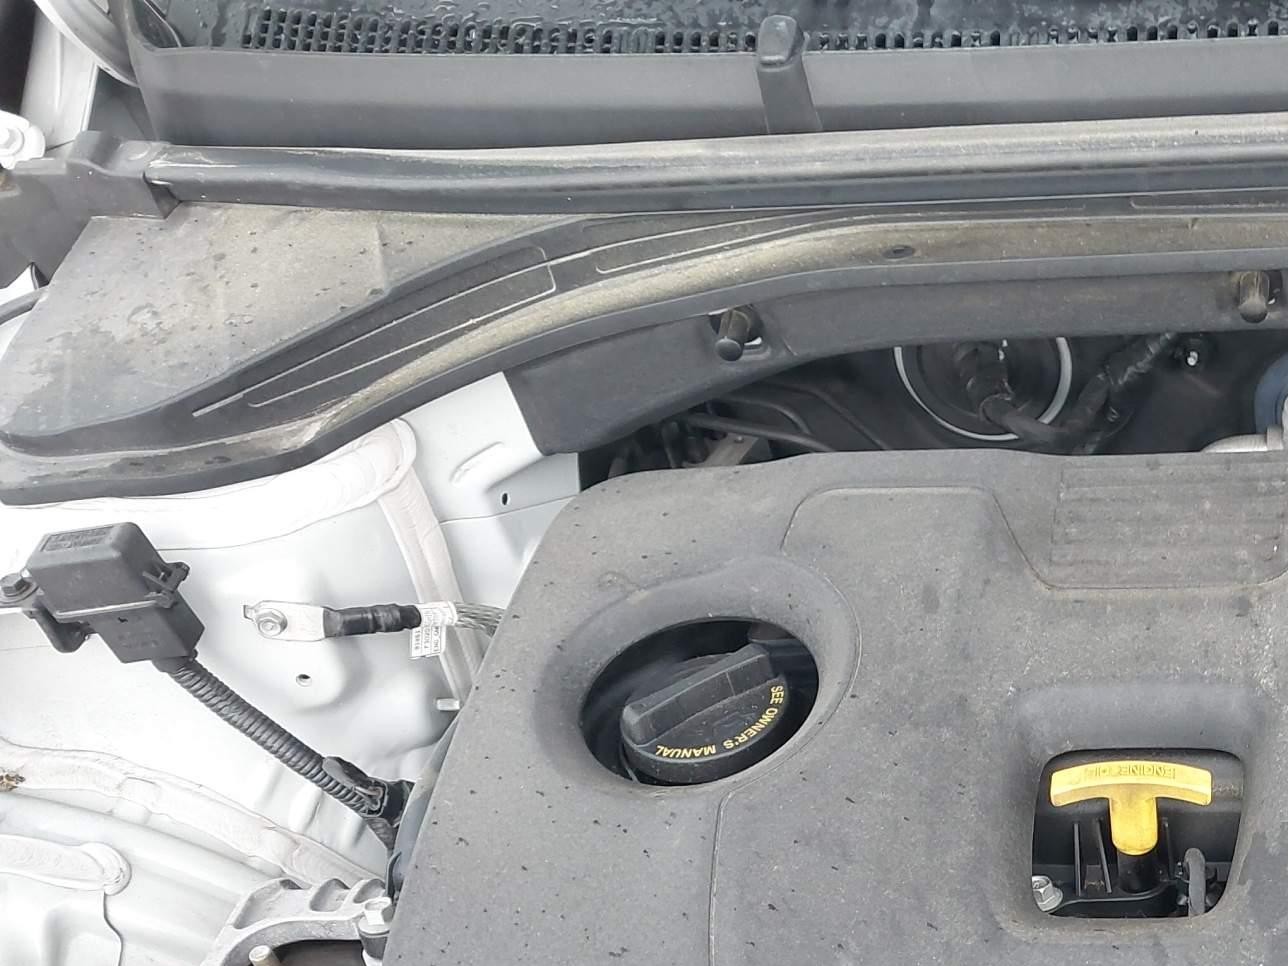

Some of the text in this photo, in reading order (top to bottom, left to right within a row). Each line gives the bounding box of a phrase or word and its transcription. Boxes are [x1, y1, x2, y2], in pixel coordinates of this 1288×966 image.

[655, 684, 785, 759] SEE OWNER'S MANUAL
